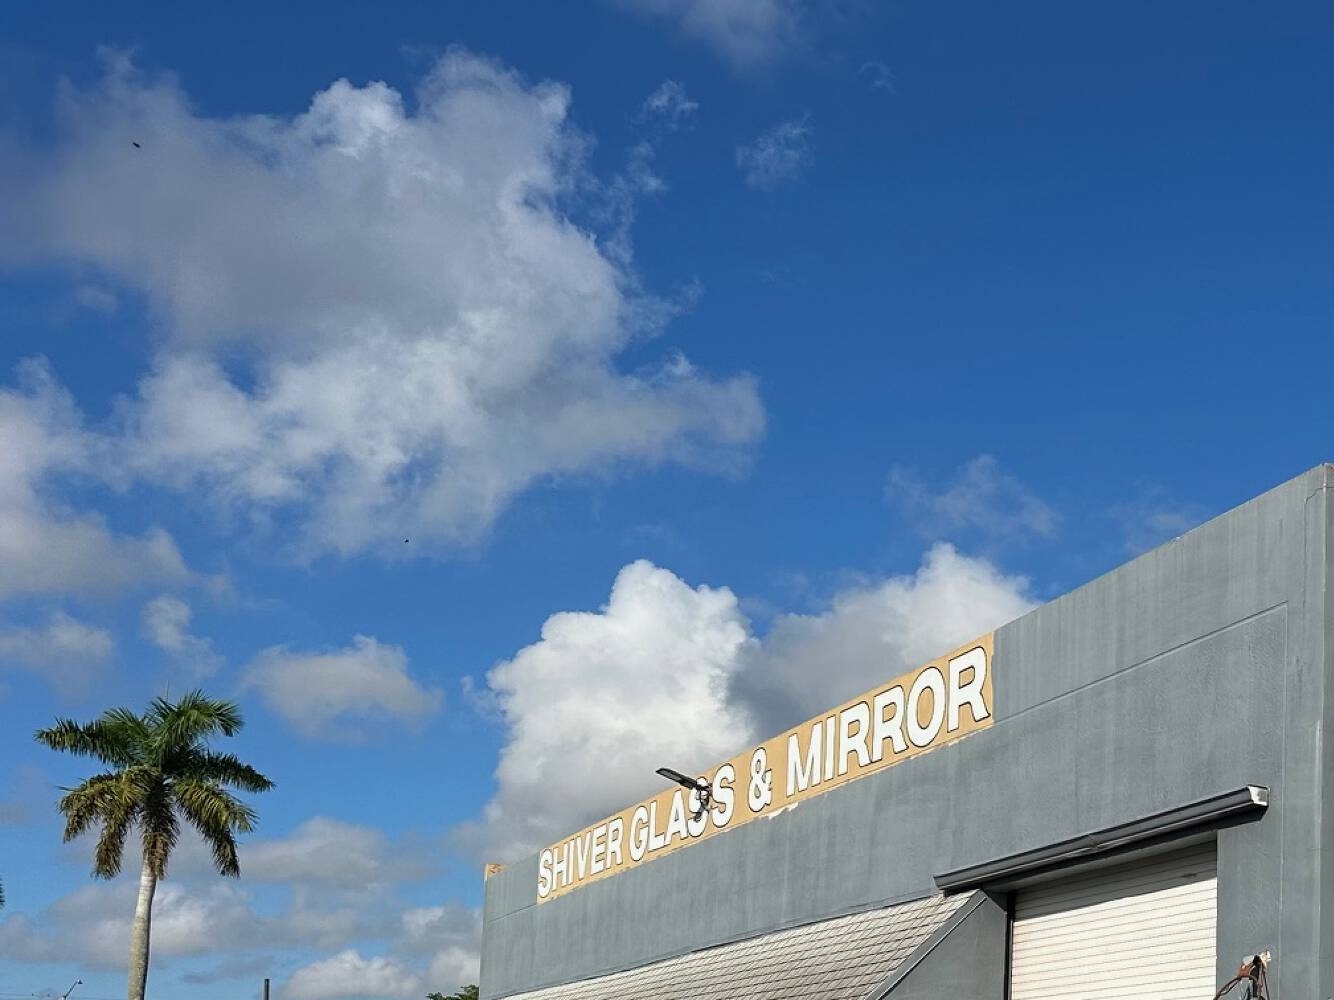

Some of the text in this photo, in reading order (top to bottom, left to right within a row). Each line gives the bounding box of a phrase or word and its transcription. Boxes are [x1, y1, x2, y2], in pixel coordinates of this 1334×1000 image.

[537, 646, 991, 899] SHIVER GLASS & MIRROR
